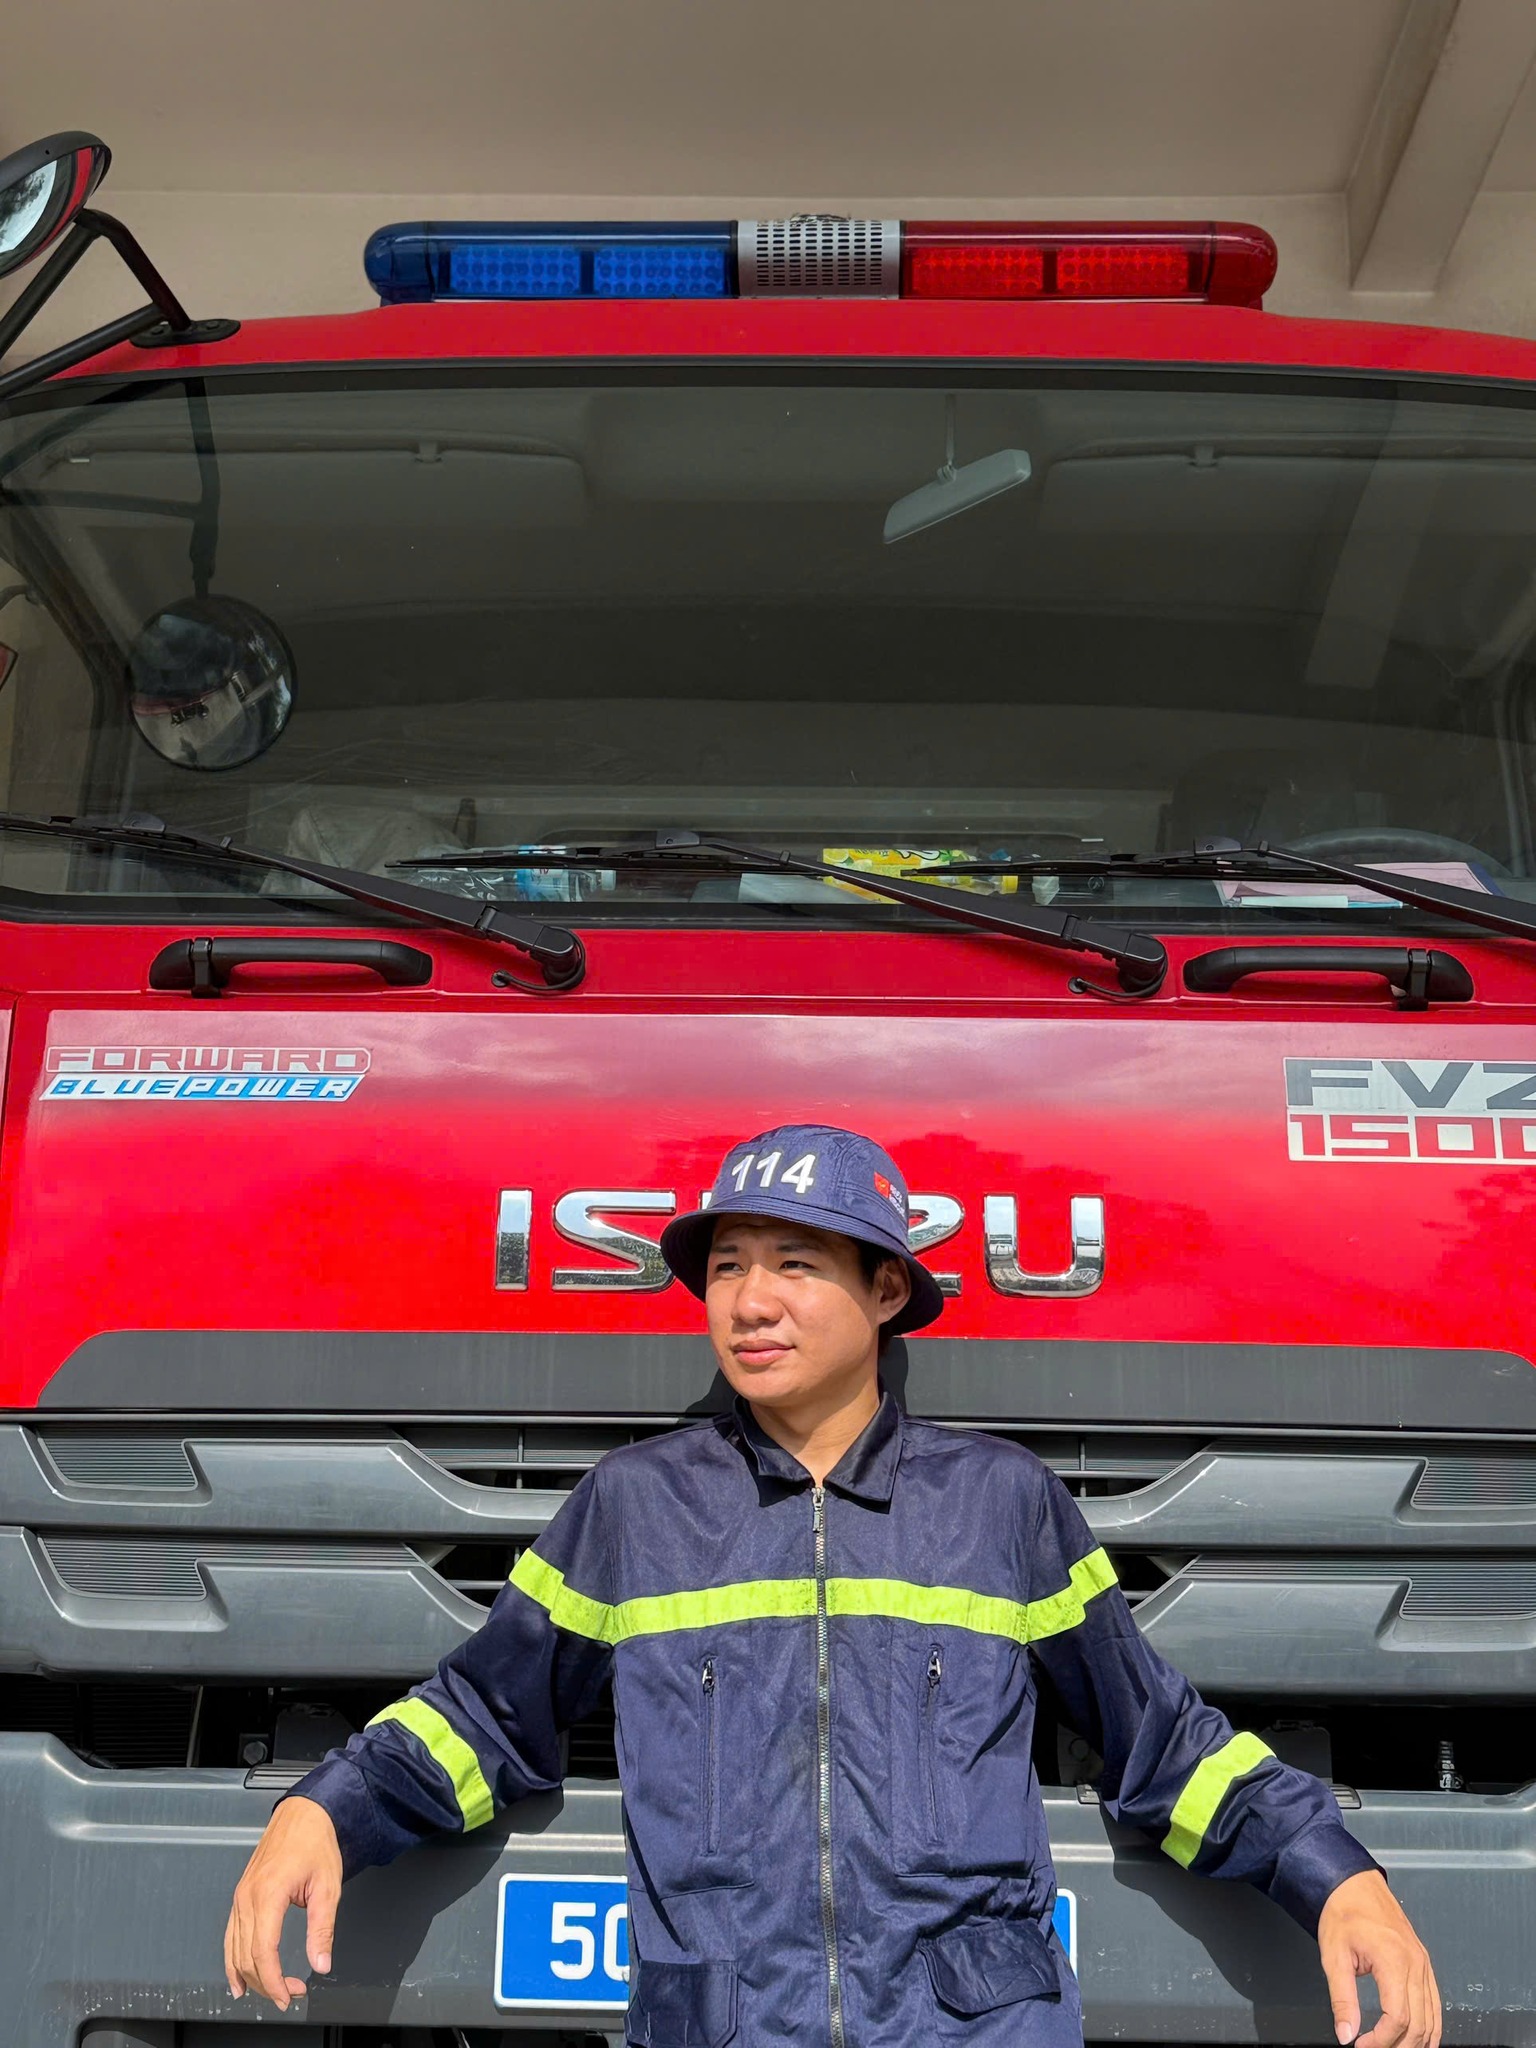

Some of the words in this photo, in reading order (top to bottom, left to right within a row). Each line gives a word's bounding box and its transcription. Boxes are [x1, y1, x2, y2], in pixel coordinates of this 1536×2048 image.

[54, 1048, 368, 1072] FORWARD
[1285, 1058, 1536, 1110] FVZ
[731, 1151, 815, 1194] 114
[495, 1187, 1107, 1299] ISU
